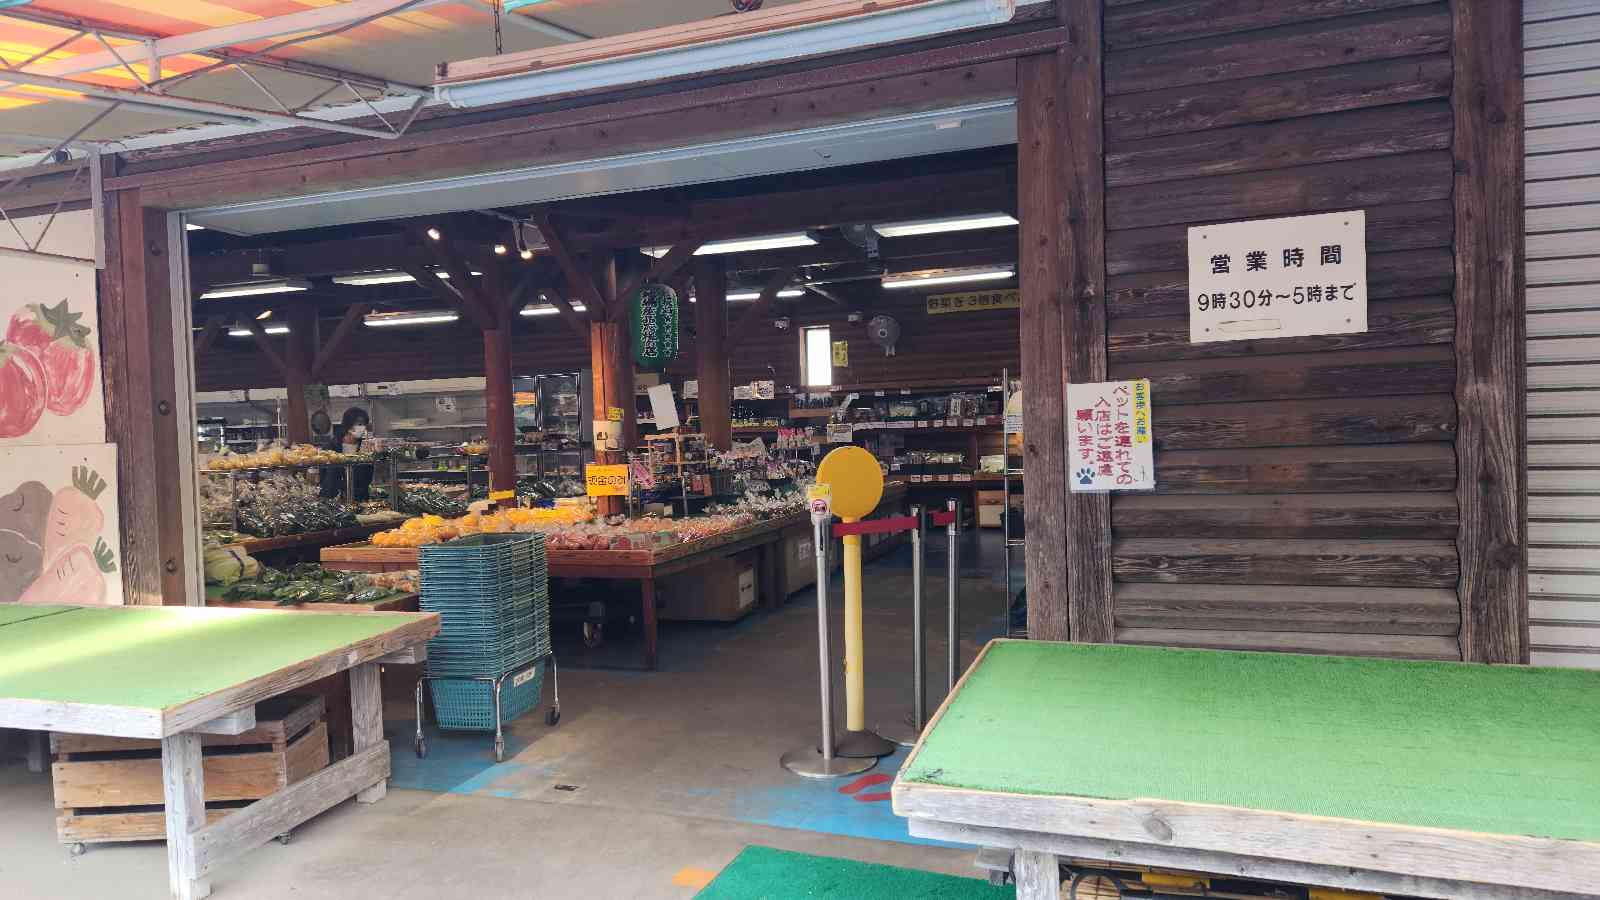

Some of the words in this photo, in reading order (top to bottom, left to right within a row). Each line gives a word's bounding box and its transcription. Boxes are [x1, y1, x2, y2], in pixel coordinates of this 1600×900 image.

[1211, 245, 1341, 274] 営業時間
[1095, 396, 1113, 476] 入店はご遠慮
[1113, 385, 1132, 485] ペットを連れての
[588, 475, 626, 488] 現金のみ
